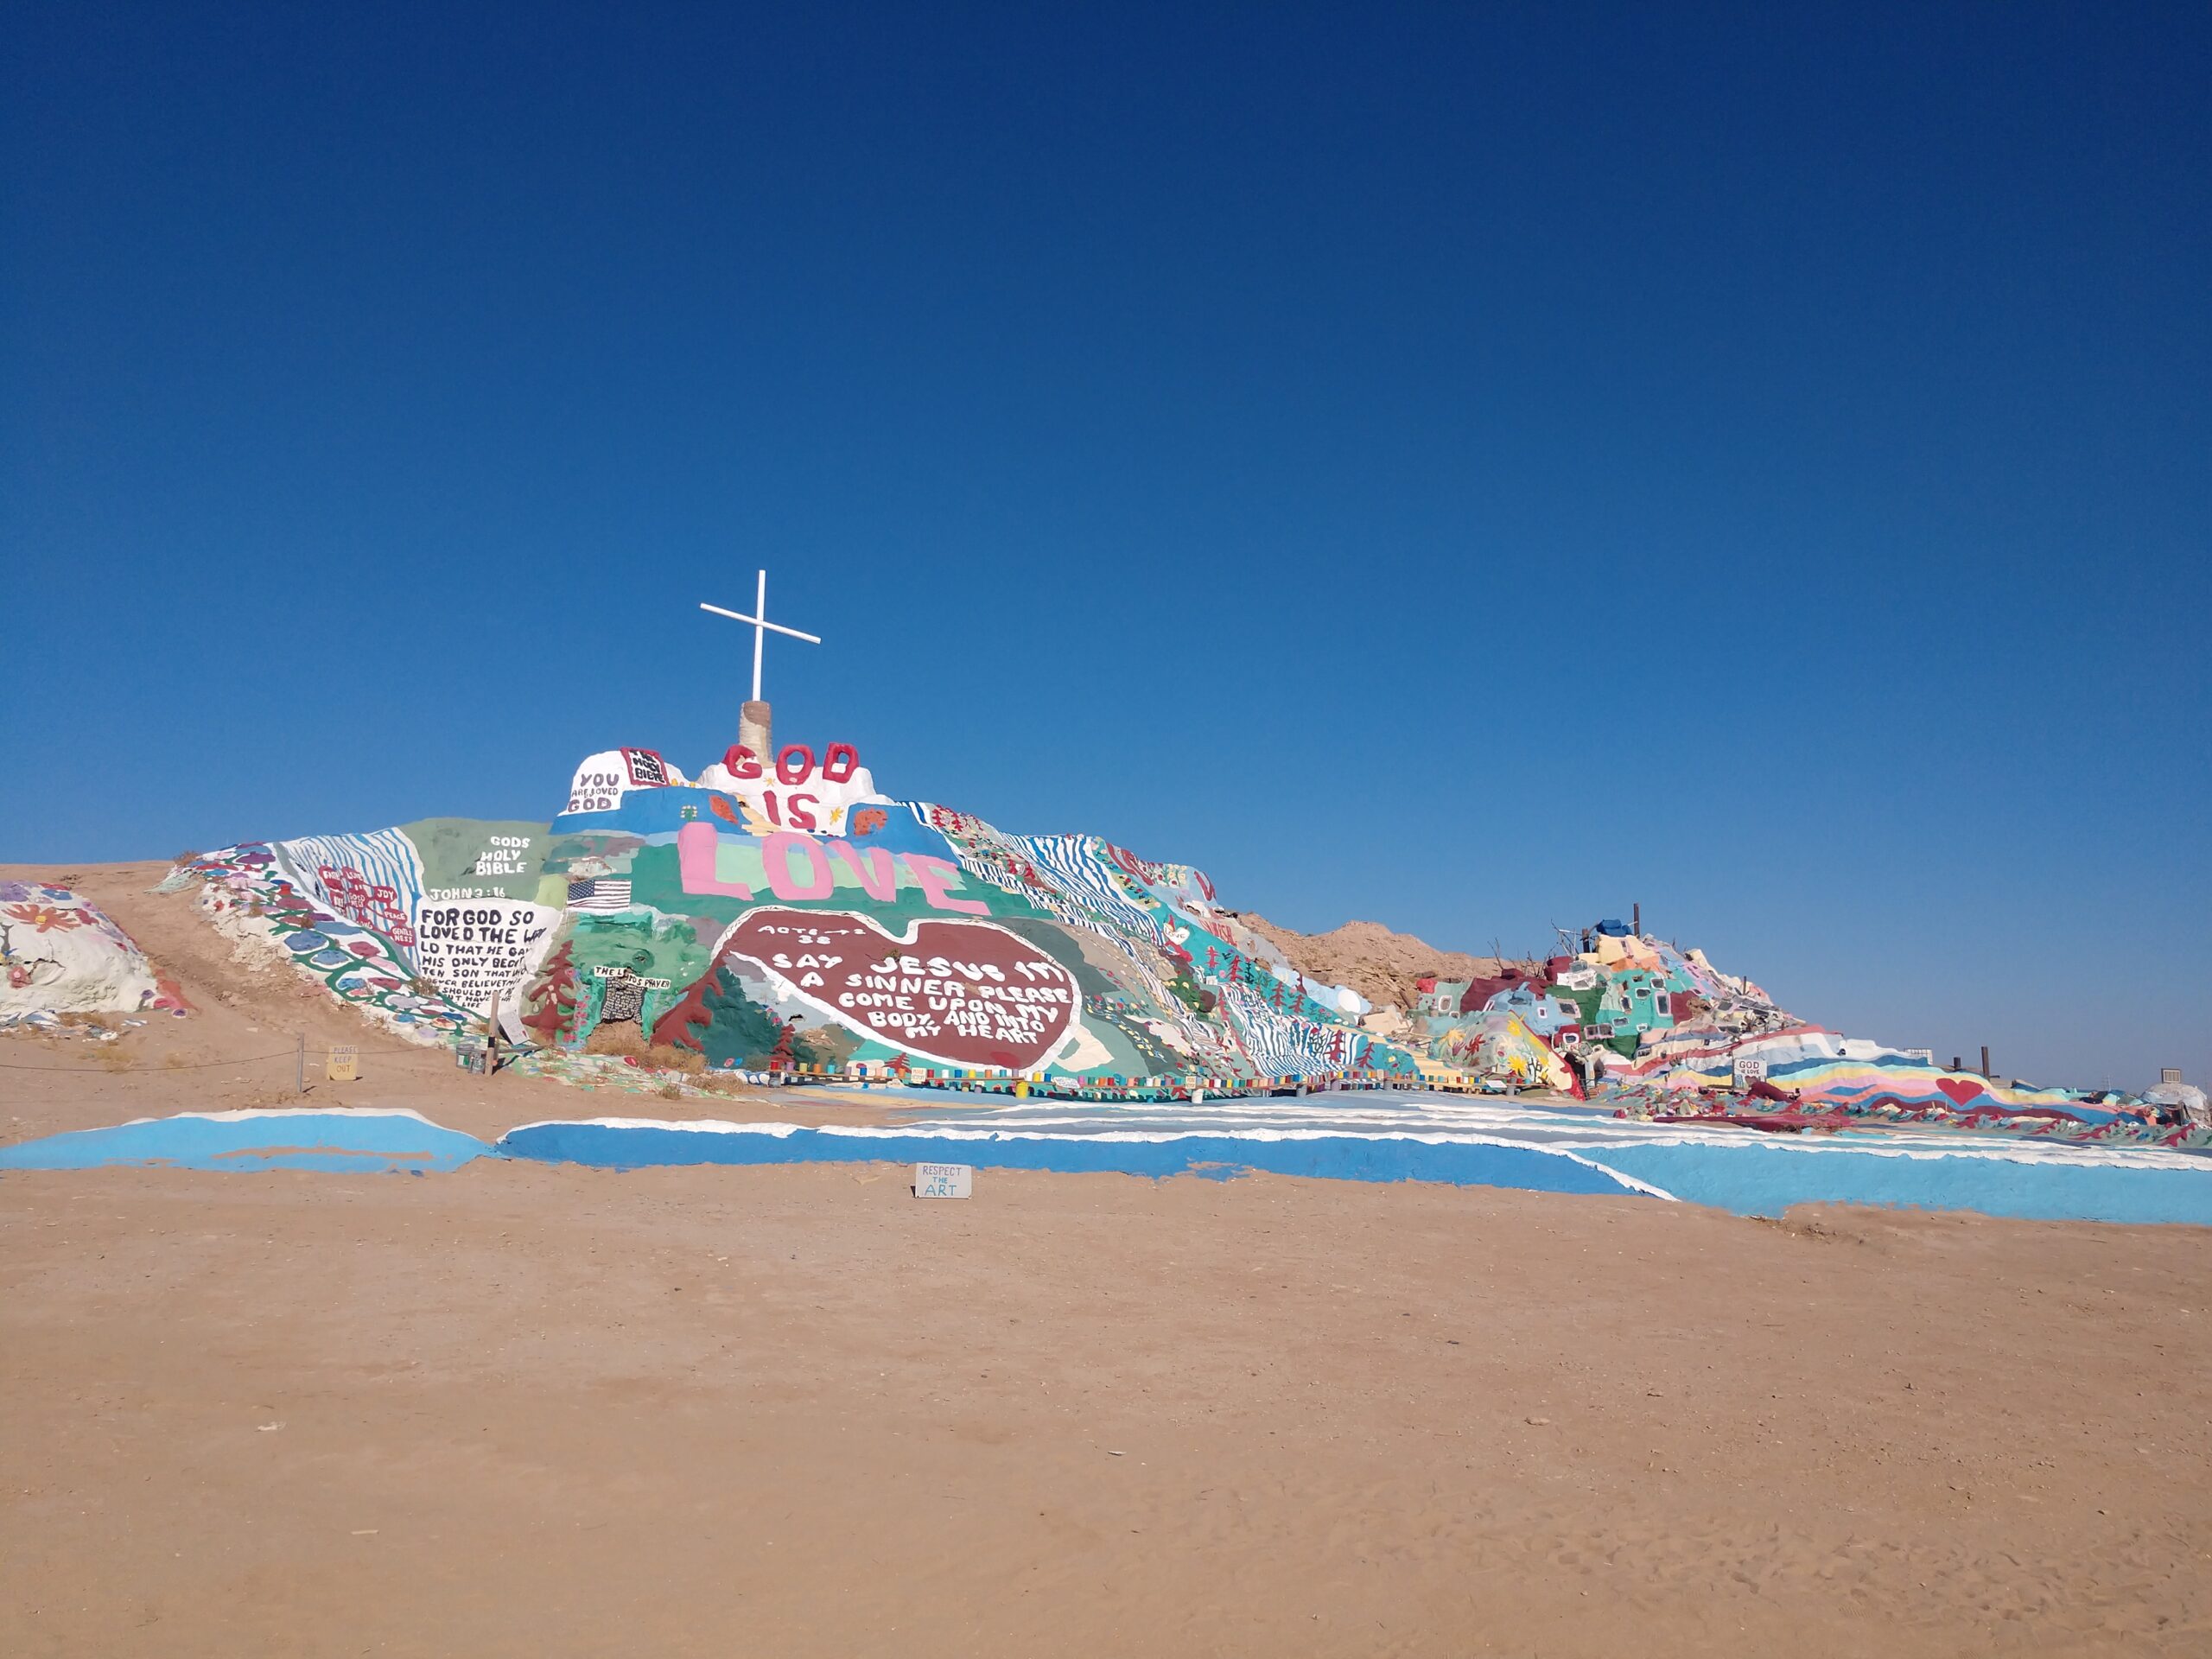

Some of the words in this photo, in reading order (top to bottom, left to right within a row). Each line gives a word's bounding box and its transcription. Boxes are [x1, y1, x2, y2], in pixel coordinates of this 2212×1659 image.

[723, 742, 860, 785] GOD
[580, 772, 620, 787] YOU
[571, 788, 588, 798] ARE
[589, 787, 619, 797] LOVED
[568, 797, 612, 813] GOD
[763, 790, 820, 829] IS
[490, 836, 531, 849] GODS
[480, 849, 521, 861] HOLY
[475, 861, 527, 876] BIBLE
[677, 822, 991, 916] LOVE
[377, 889, 394, 899] JOY
[430, 887, 472, 900] JOHN
[422, 908, 461, 926] FOR
[462, 909, 502, 925] GOD
[509, 911, 534, 926] SO
[420, 925, 474, 941] LOVED
[479, 927, 518, 944] THE
[798, 935, 830, 944] 38
[421, 941, 439, 954] LD
[446, 944, 483, 955] THAT
[486, 946, 503, 956] HE
[423, 956, 445, 968] HIS
[452, 957, 488, 967] ONLY
[772, 953, 843, 969] SAY
[870, 956, 1006, 982] JESUS
[423, 967, 445, 977] TEN
[453, 969, 480, 977] SON
[595, 966, 615, 976] THE
[442, 987, 481, 996] SHOULD
[800, 971, 824, 988] A
[845, 973, 966, 998] SINNER
[977, 986, 1072, 1004] PLEASE
[838, 992, 915, 1011] COME
[928, 996, 1007, 1015] UPON
[1014, 1003, 1058, 1023] MY
[943, 1010, 990, 1027] AND
[995, 1014, 1046, 1033] INTO
[905, 1025, 941, 1039] MY
[957, 1024, 1038, 1045] HEART
[334, 1046, 357, 1054] PLEASE
[1739, 1060, 1760, 1070] GOD
[922, 1165, 962, 1176] RESPECT
[924, 1184, 957, 1197] ART
